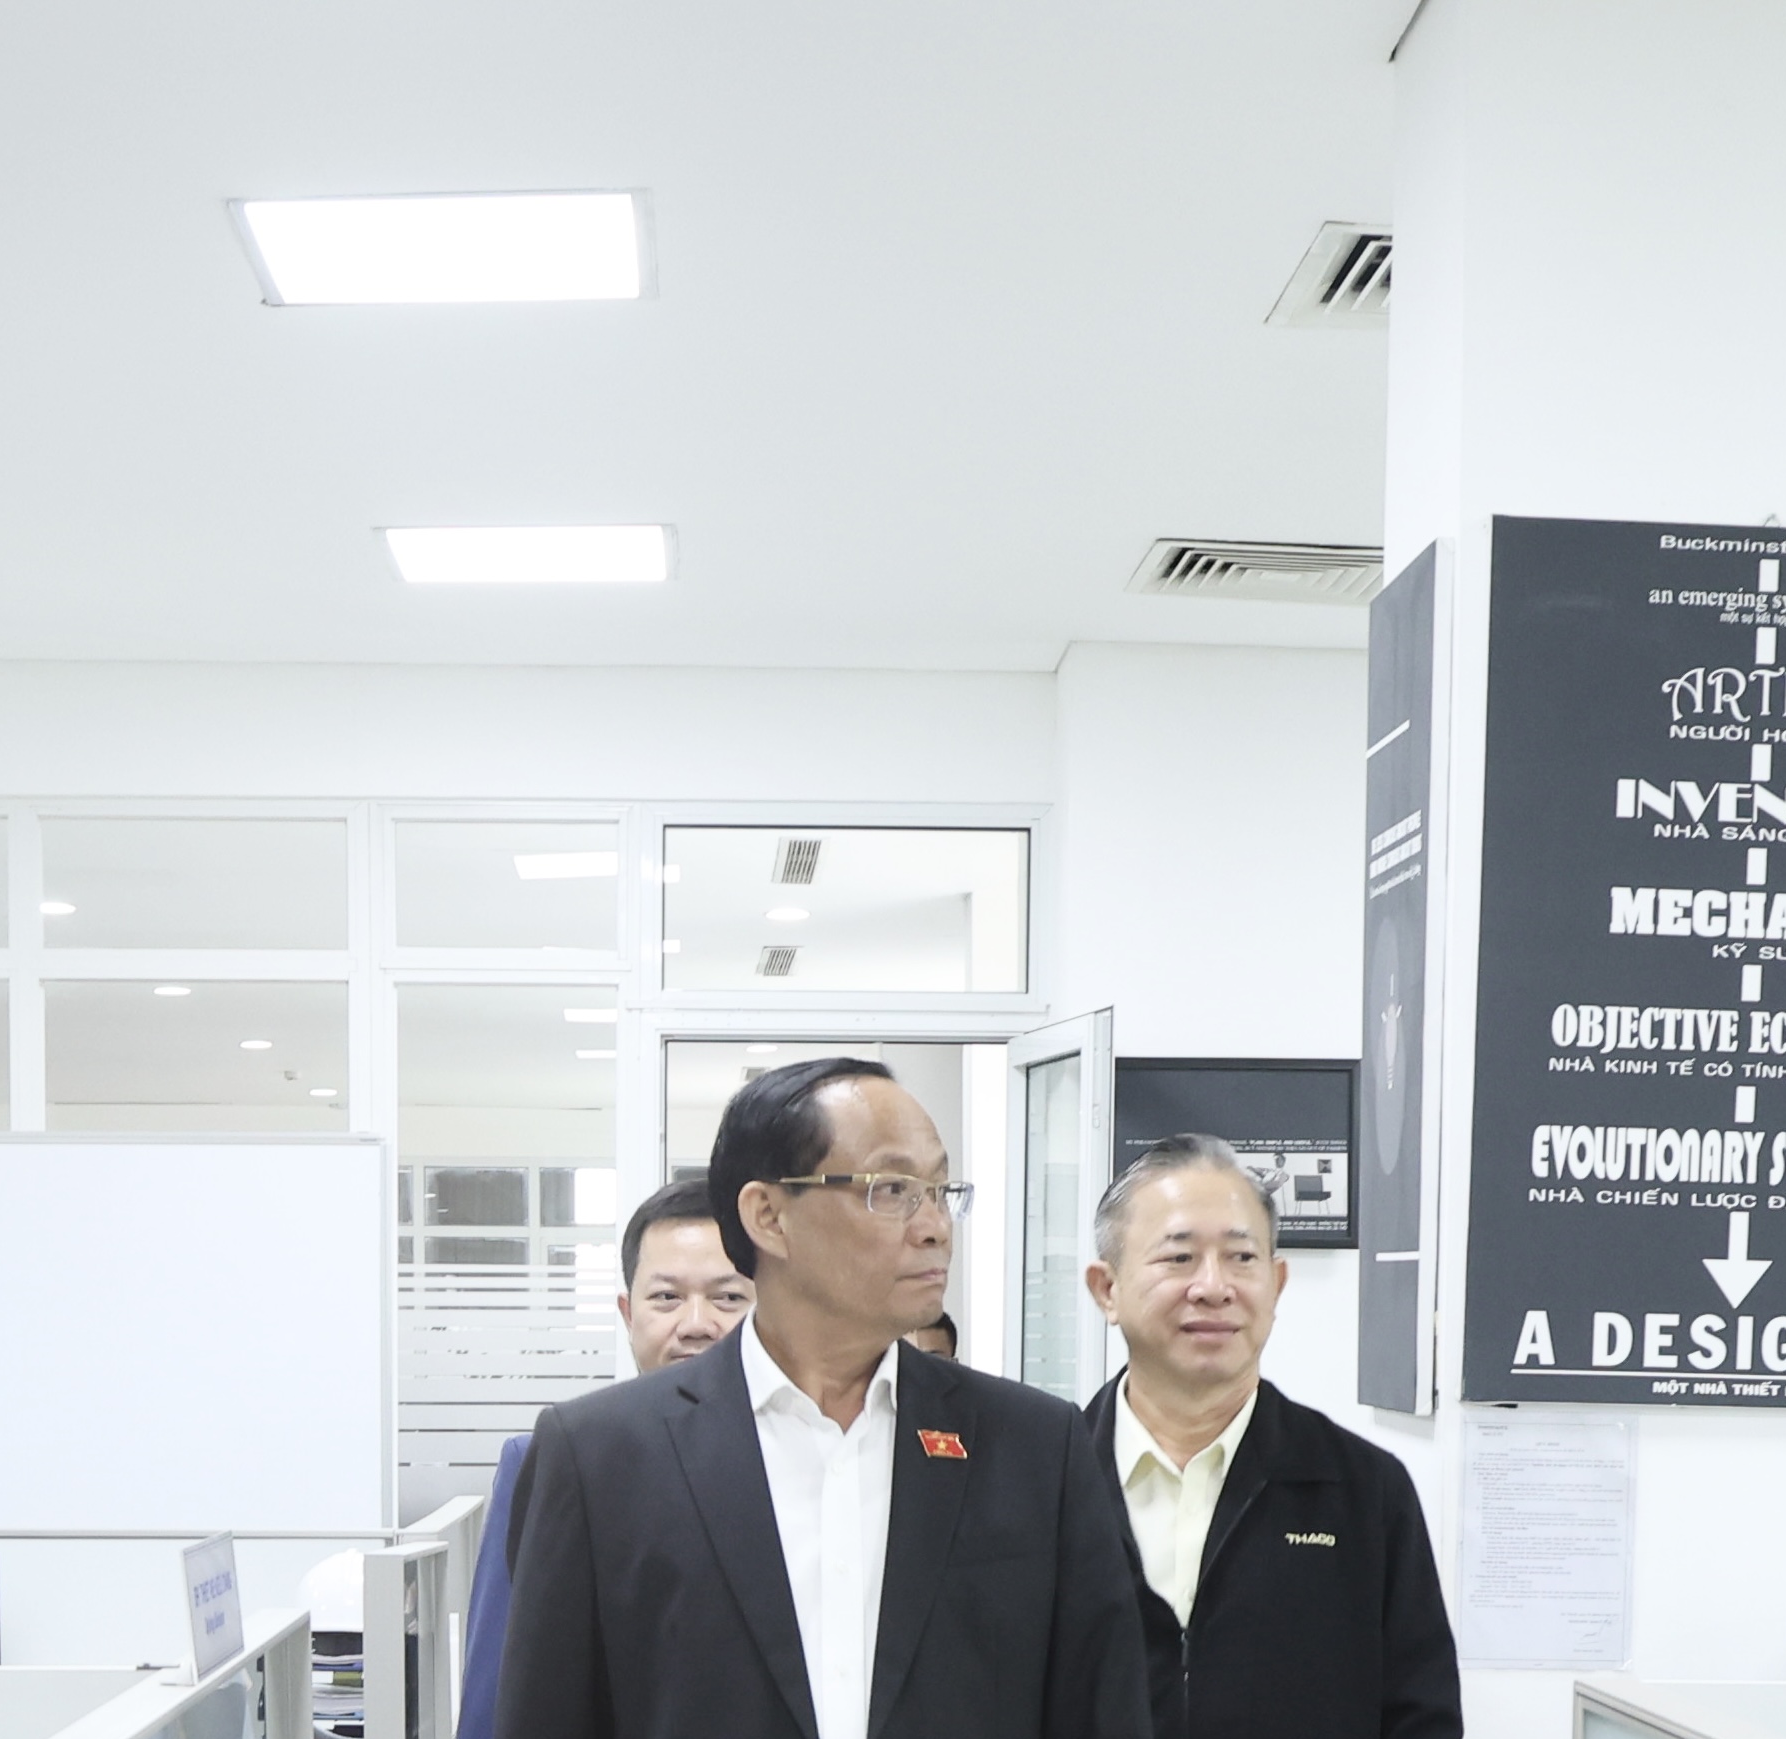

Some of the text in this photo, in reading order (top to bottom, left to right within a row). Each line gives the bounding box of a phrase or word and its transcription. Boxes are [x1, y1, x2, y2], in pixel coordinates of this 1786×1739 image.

[1648, 589, 1673, 605] an
[1677, 589, 1769, 612] emerging
[1669, 725, 1750, 741] NGƯỜI
[1654, 822, 1710, 839] NHÀ
[1712, 943, 1748, 959] KỸ
[1551, 1004, 1738, 1052] OBJECTIVE
[1548, 1057, 1595, 1072] NHÀ
[1604, 1060, 1657, 1075] KINH
[1667, 1059, 1696, 1076] TẾ
[1703, 1060, 1733, 1078] CÓ
[1532, 1125, 1765, 1184] EVOLUTIONARY
[1528, 1186, 1585, 1204] NHÀ
[1596, 1188, 1678, 1207] CHIẾN
[1691, 1192, 1757, 1211] LƯỢC
[1513, 1311, 1555, 1367] A
[1653, 1380, 1688, 1397] MỘT
[1693, 1380, 1728, 1395] NHÀ
[1732, 1380, 1781, 1397] THIẾT
